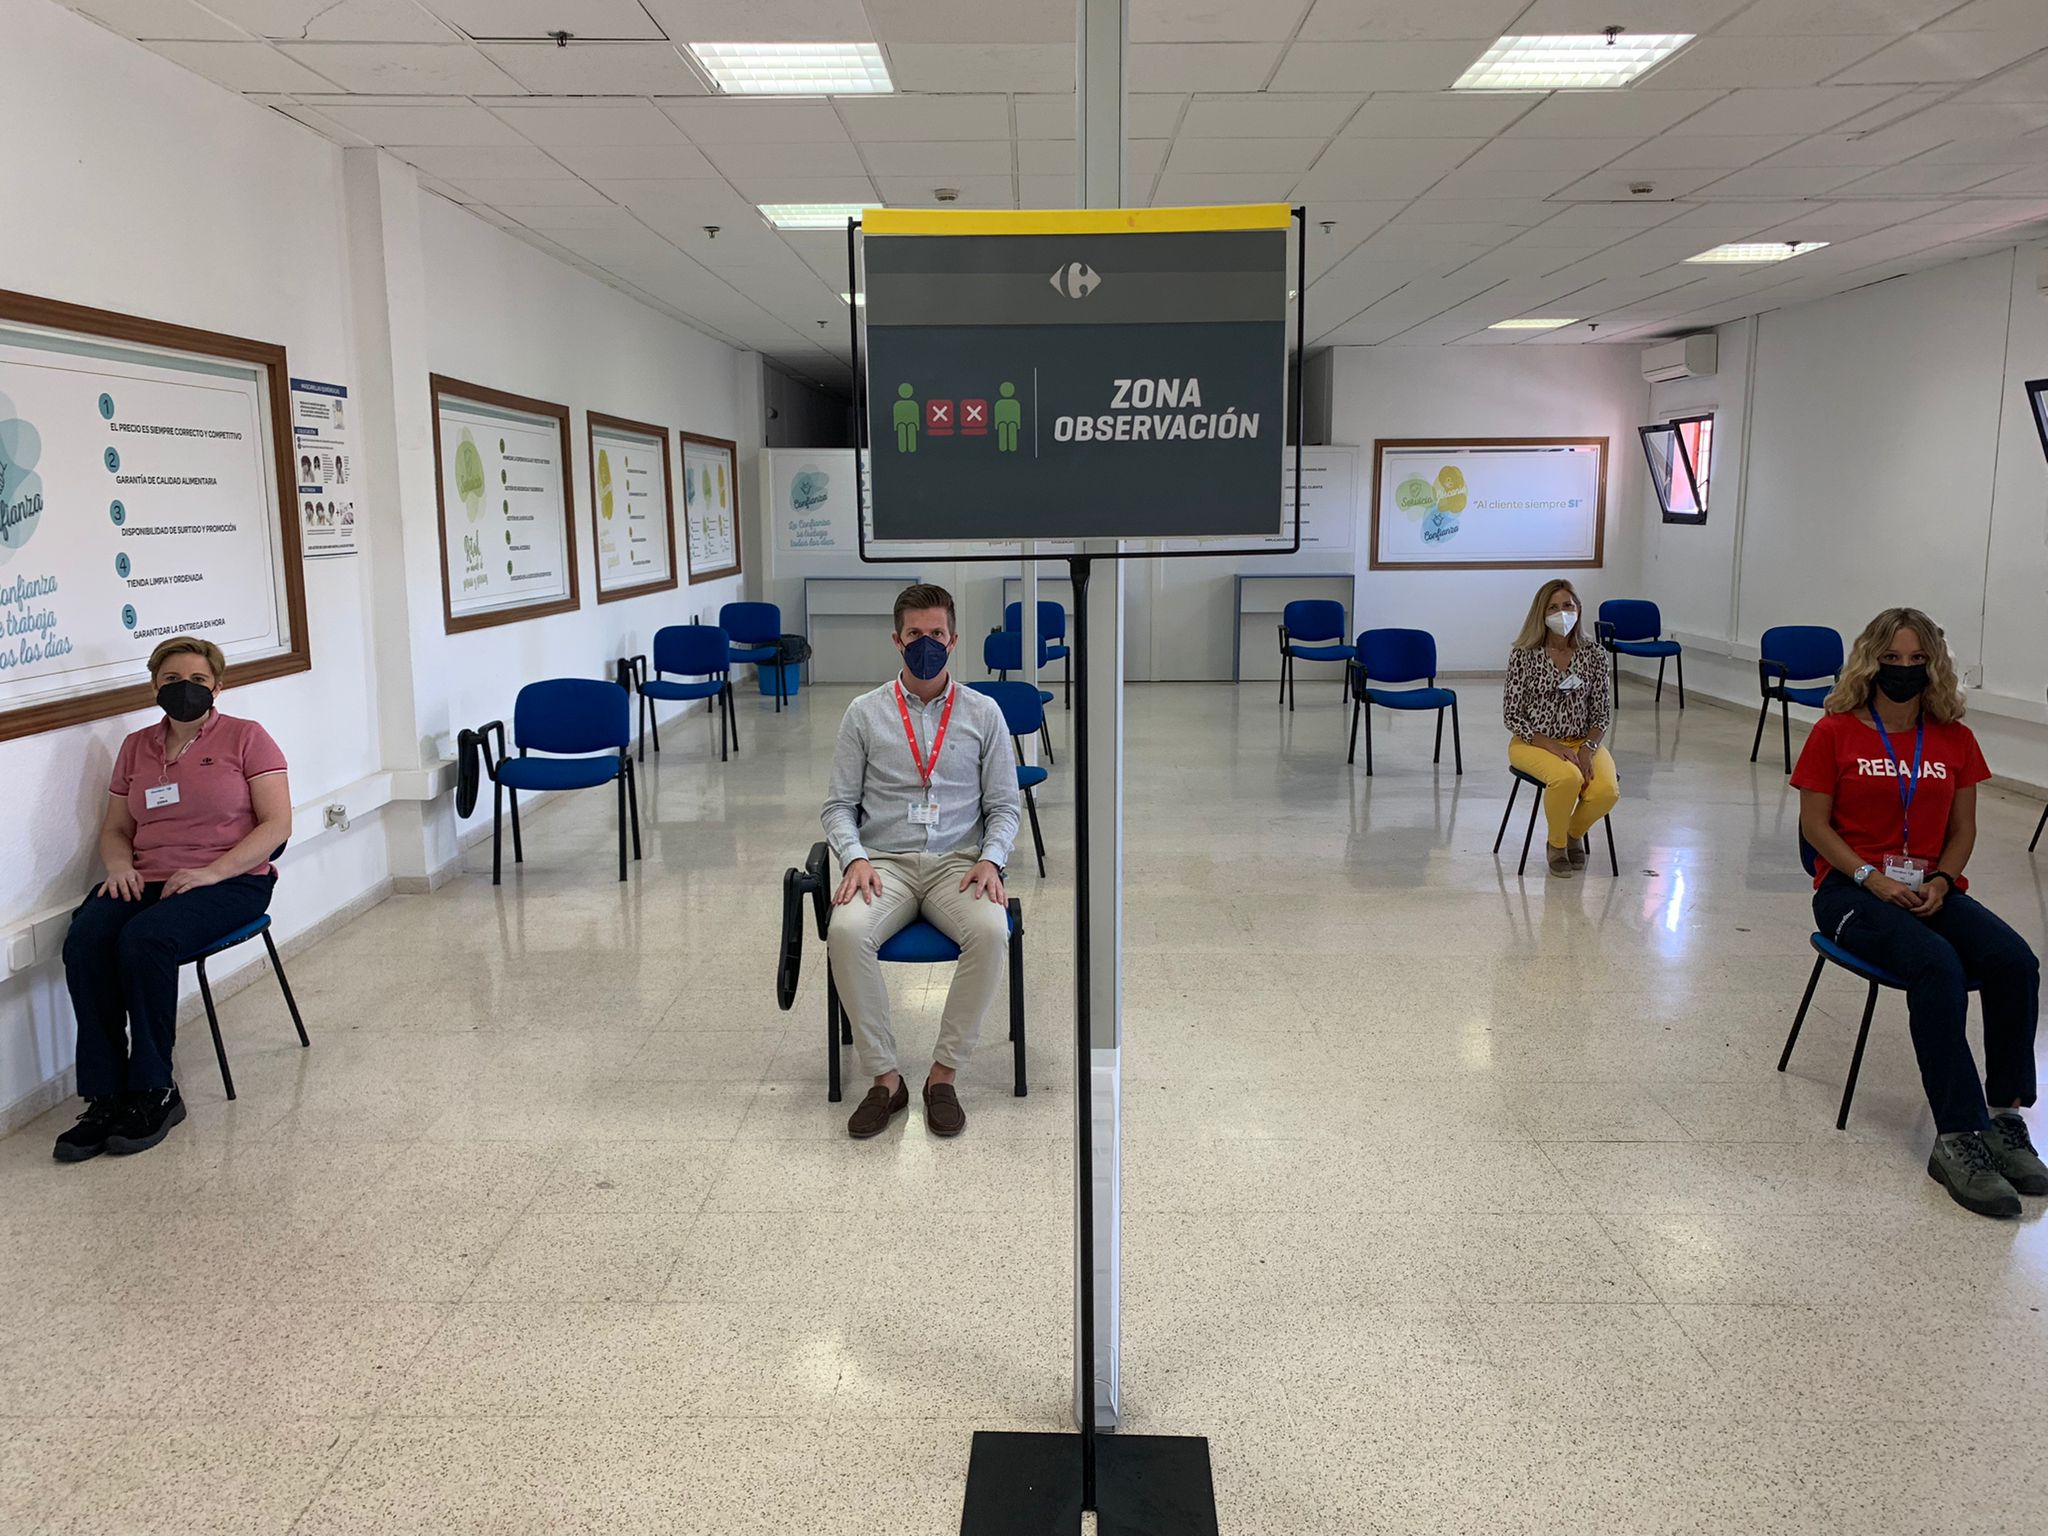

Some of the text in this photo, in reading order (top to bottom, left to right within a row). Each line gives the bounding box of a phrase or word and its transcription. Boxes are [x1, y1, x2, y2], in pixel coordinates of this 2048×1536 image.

[1110, 378, 1202, 409] ZONA
[103, 399, 110, 415] 1
[110, 422, 118, 432] EL
[119, 423, 142, 433] PRECIO
[142, 425, 150, 434] ES
[150, 426, 174, 436] SIEMPRE
[174, 428, 204, 438] CORRECTO
[208, 430, 242, 441] COMPETITIVO
[1054, 406, 1260, 442] OBSERVACIÓN
[108, 452, 116, 468] 2
[116, 474, 217, 486] GARANTÍA DE CALIDAD ALIMENTARIA
[114, 505, 122, 520] 3
[1489, 500, 1524, 509] cliente
[1525, 500, 1566, 511] siempre
[121, 527, 168, 537] DISPONIBILIDAD
[169, 526, 177, 535] DE
[177, 525, 201, 534] SURTIDO
[206, 522, 237, 533] PROMOCIÓN
[1424, 526, 1459, 541] Confianza
[119, 558, 127, 572] 4
[127, 578, 149, 588] TIENDA
[150, 576, 168, 586] LIMPIA
[174, 573, 204, 584] ORDENADA
[0, 574, 58, 612] onfianza
[6, 605, 57, 640] trabaja
[125, 609, 134, 625] 5
[133, 618, 226, 640] GARANTIZAR LA ENTREGA EN HORA
[20, 638, 43, 665] los
